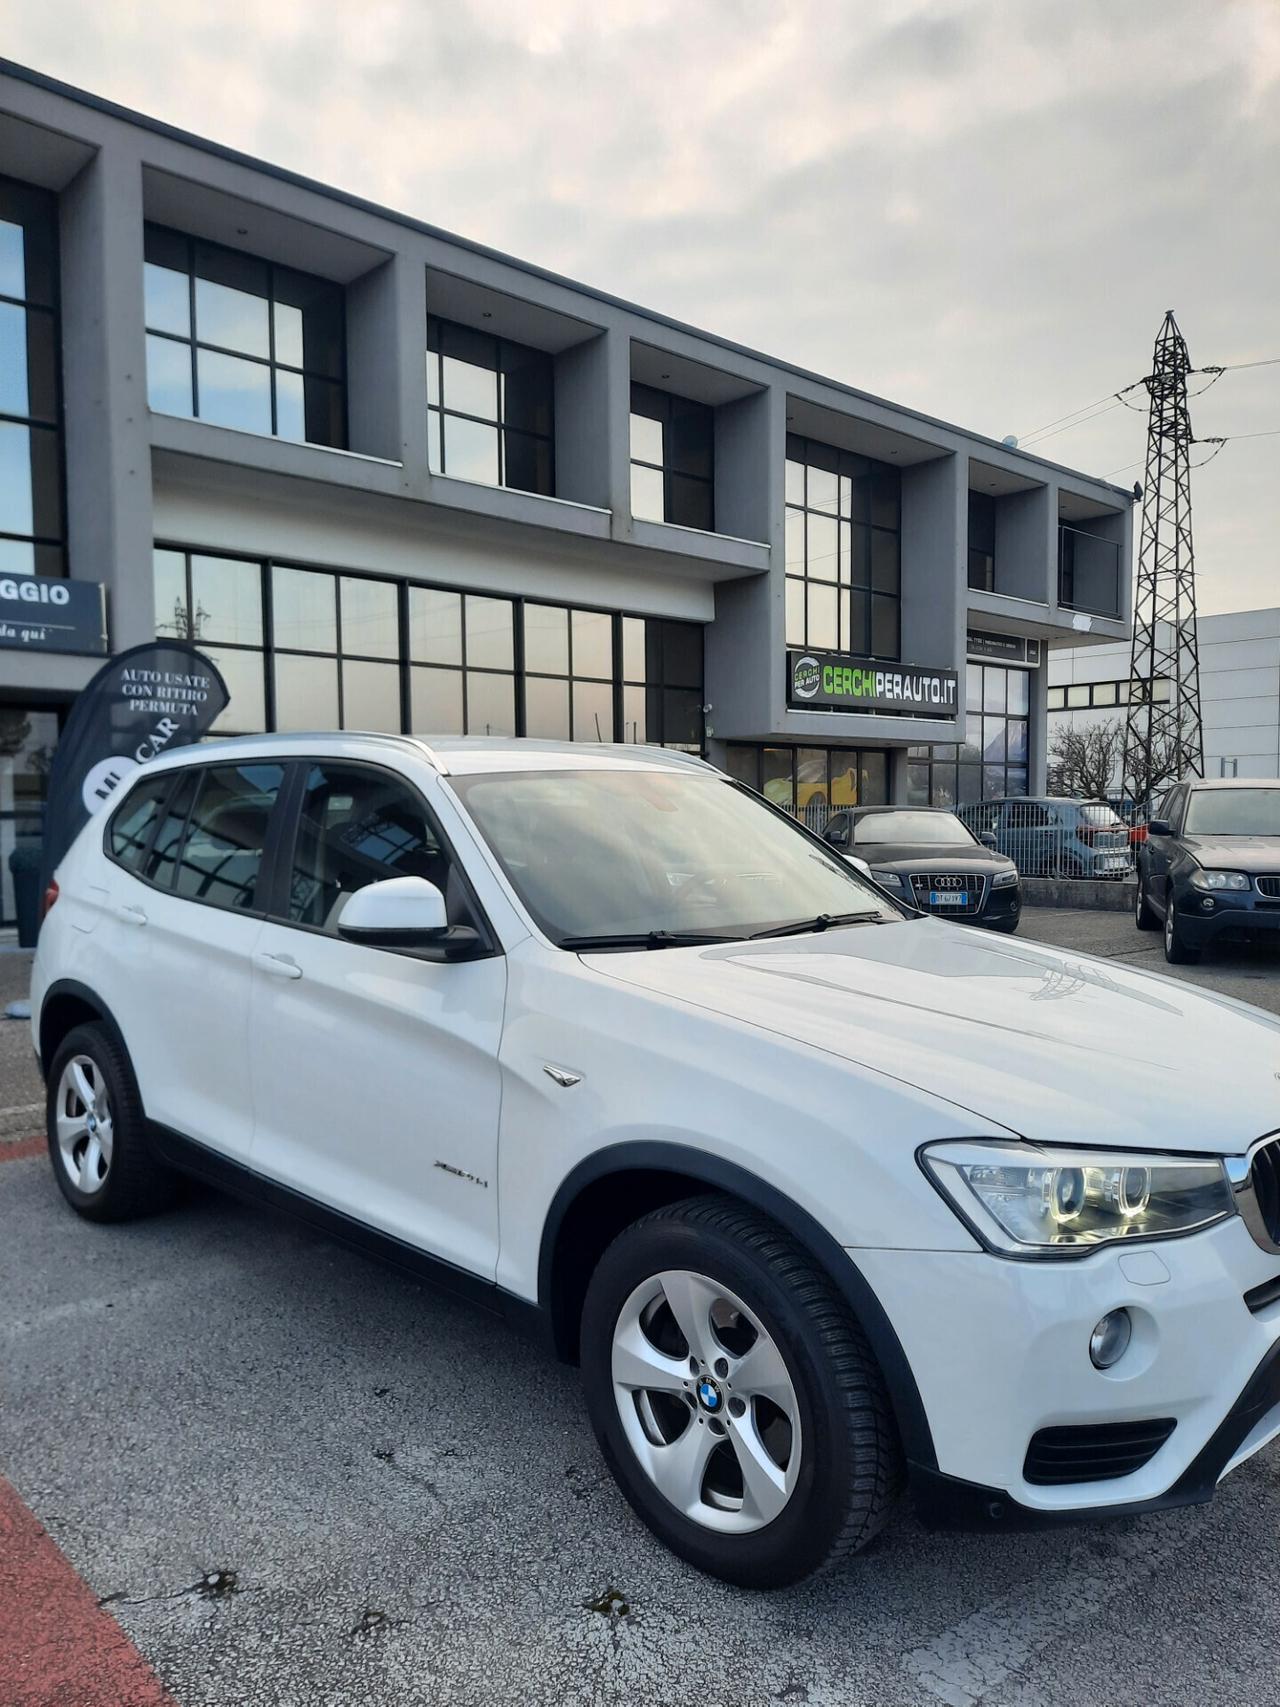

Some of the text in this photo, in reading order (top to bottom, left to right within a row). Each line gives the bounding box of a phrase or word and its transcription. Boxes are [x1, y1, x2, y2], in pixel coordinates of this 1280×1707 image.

[121, 668, 210, 688] AUTO USATE
[794, 666, 820, 682] CERCHI
[805, 674, 820, 686] AUTO
[122, 684, 207, 702] CON RITIRO
[823, 665, 956, 705] CERCHIPERAUTO.IT
[130, 699, 198, 716] PERMUTA
[135, 717, 180, 764] CAR
